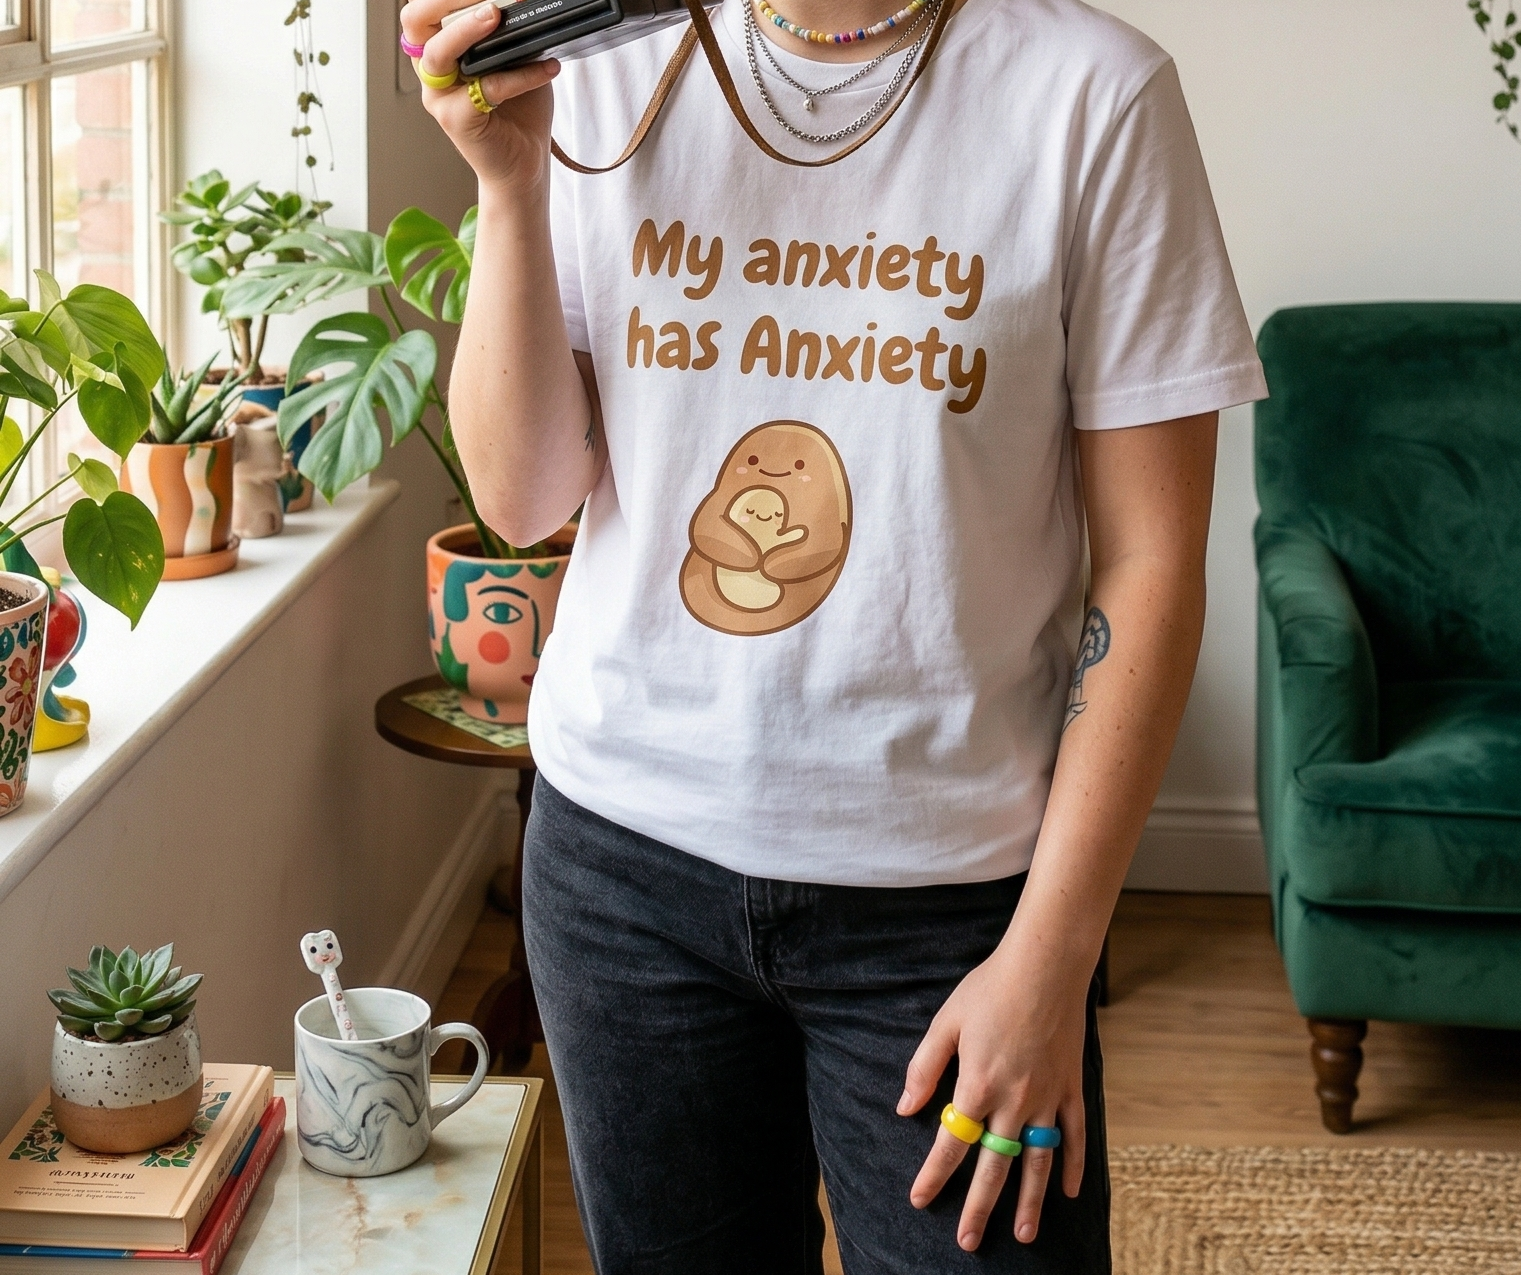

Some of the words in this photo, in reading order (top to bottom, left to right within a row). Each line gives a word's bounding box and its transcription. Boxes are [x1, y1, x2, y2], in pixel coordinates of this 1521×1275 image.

[632, 218, 724, 300] My
[742, 231, 985, 321] anxiety
[627, 306, 722, 371] has
[740, 315, 987, 414] Anxiety
